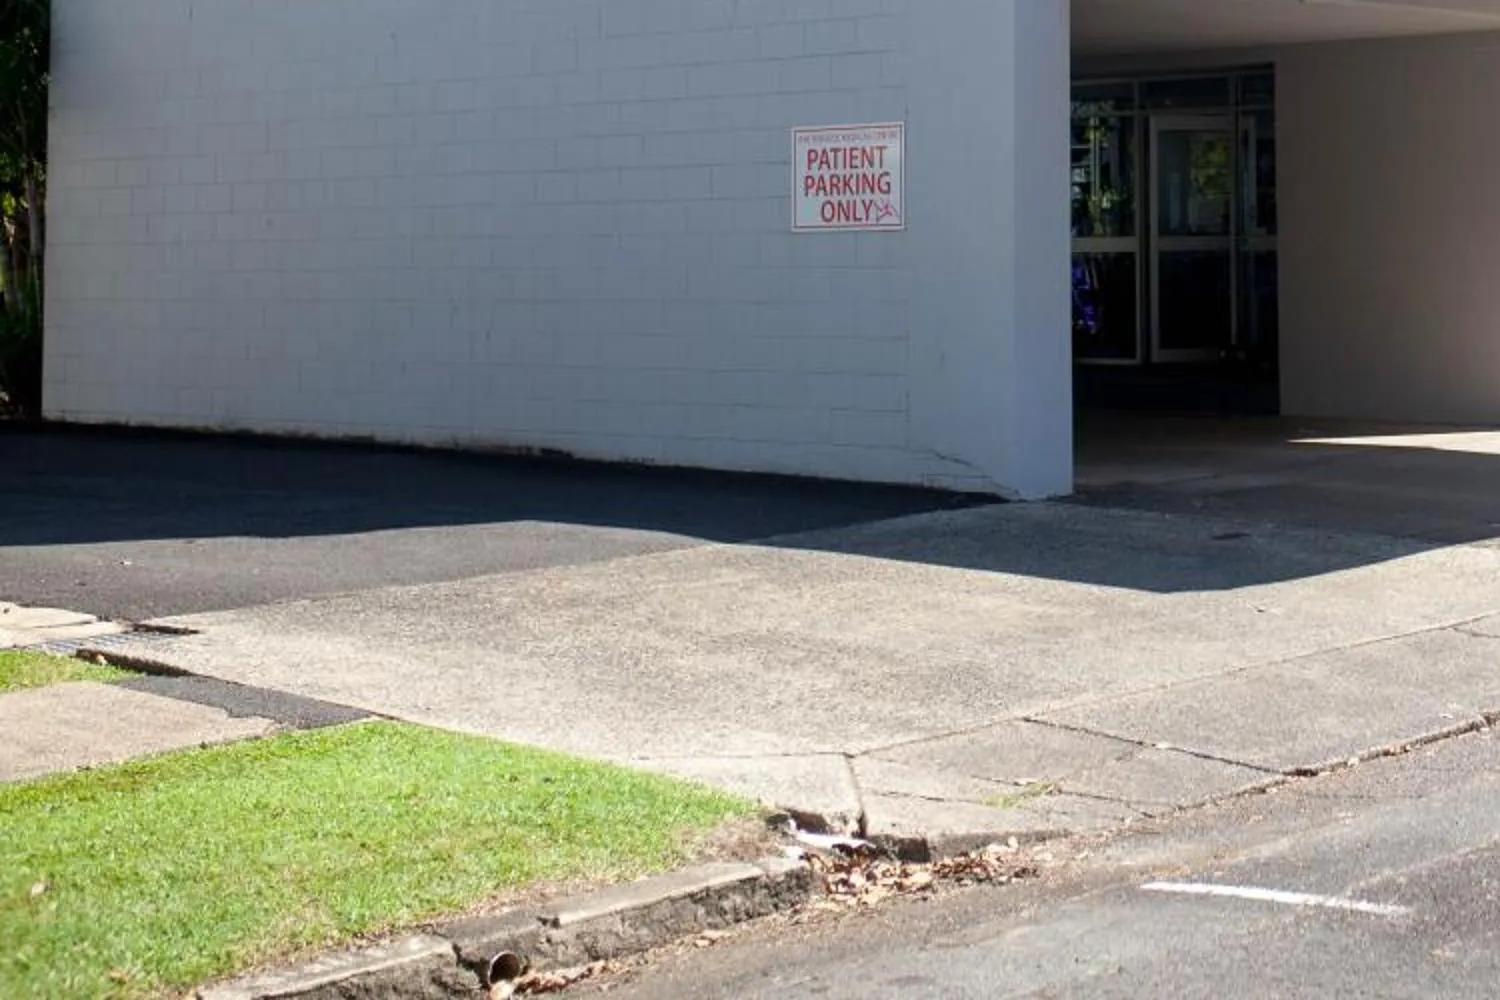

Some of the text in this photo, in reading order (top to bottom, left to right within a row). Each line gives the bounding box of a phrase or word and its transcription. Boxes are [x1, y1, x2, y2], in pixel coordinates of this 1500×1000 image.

[807, 146, 888, 170] PATIENT
[804, 172, 891, 197] PARKING
[821, 199, 874, 223] ONLY
